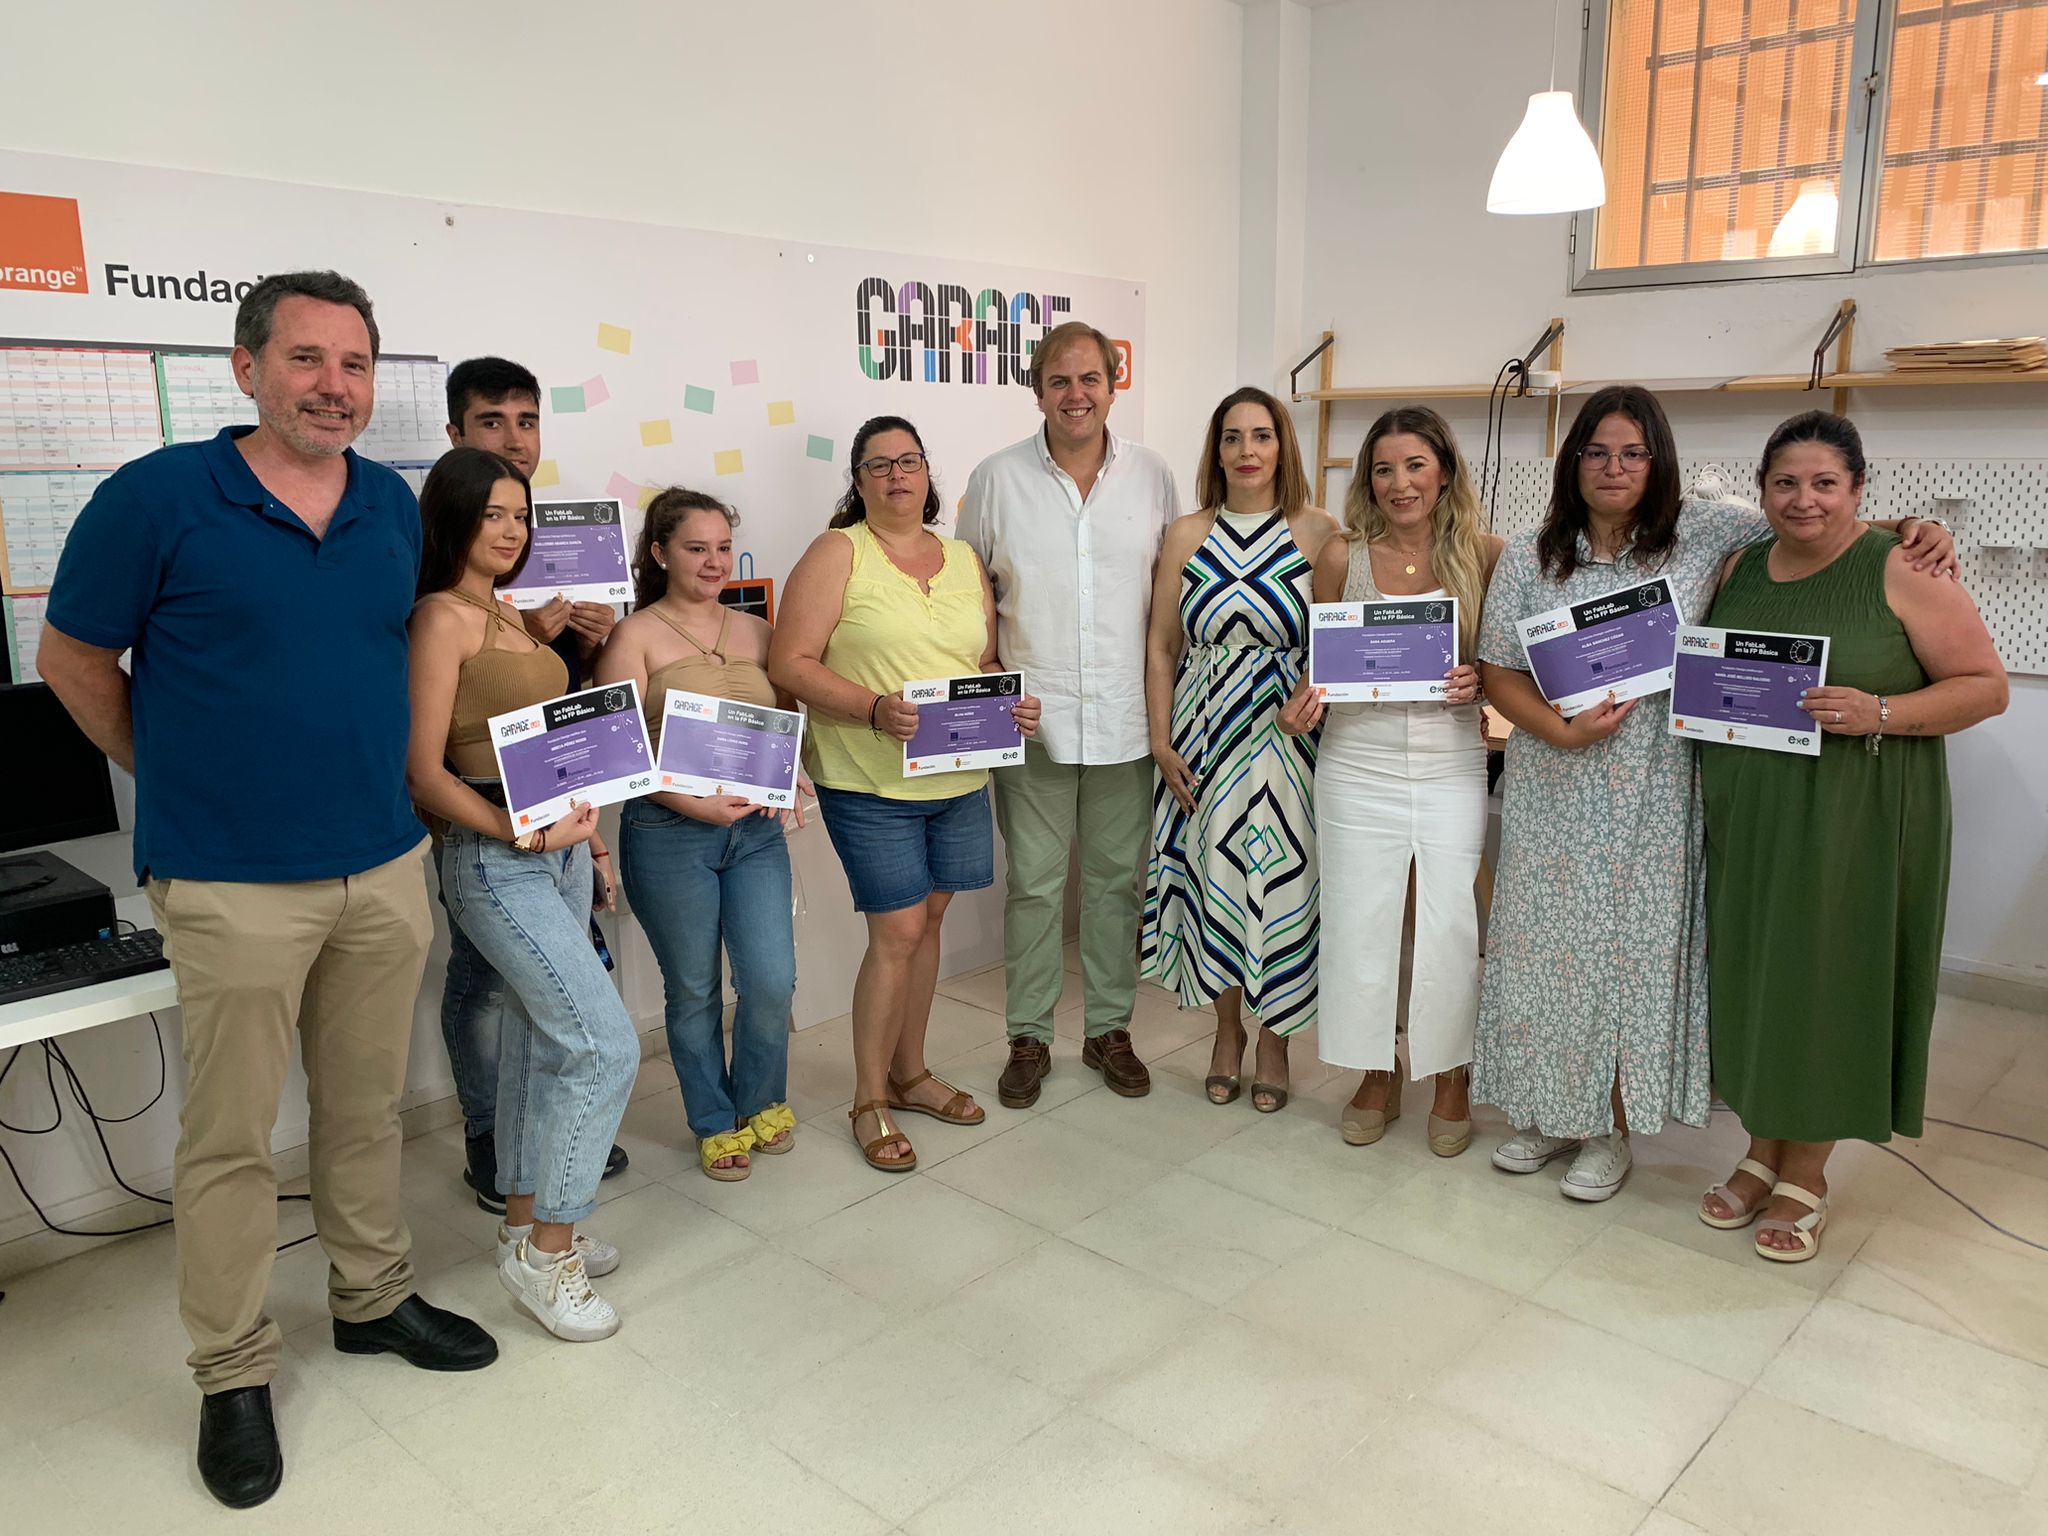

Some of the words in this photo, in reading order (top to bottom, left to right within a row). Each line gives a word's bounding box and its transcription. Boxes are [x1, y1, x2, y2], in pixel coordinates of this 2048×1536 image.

[104, 263, 264, 303] Fundac
[609, 587, 626, 595] exe
[1592, 603, 1615, 614] FabLab
[1609, 603, 1630, 615] Básica
[1526, 621, 1558, 638] GARAGE
[562, 703, 582, 714] FabLab
[576, 706, 595, 716] Básica
[1788, 736, 1810, 746] exe
[629, 777, 651, 791] exe
[768, 793, 786, 802] exe
